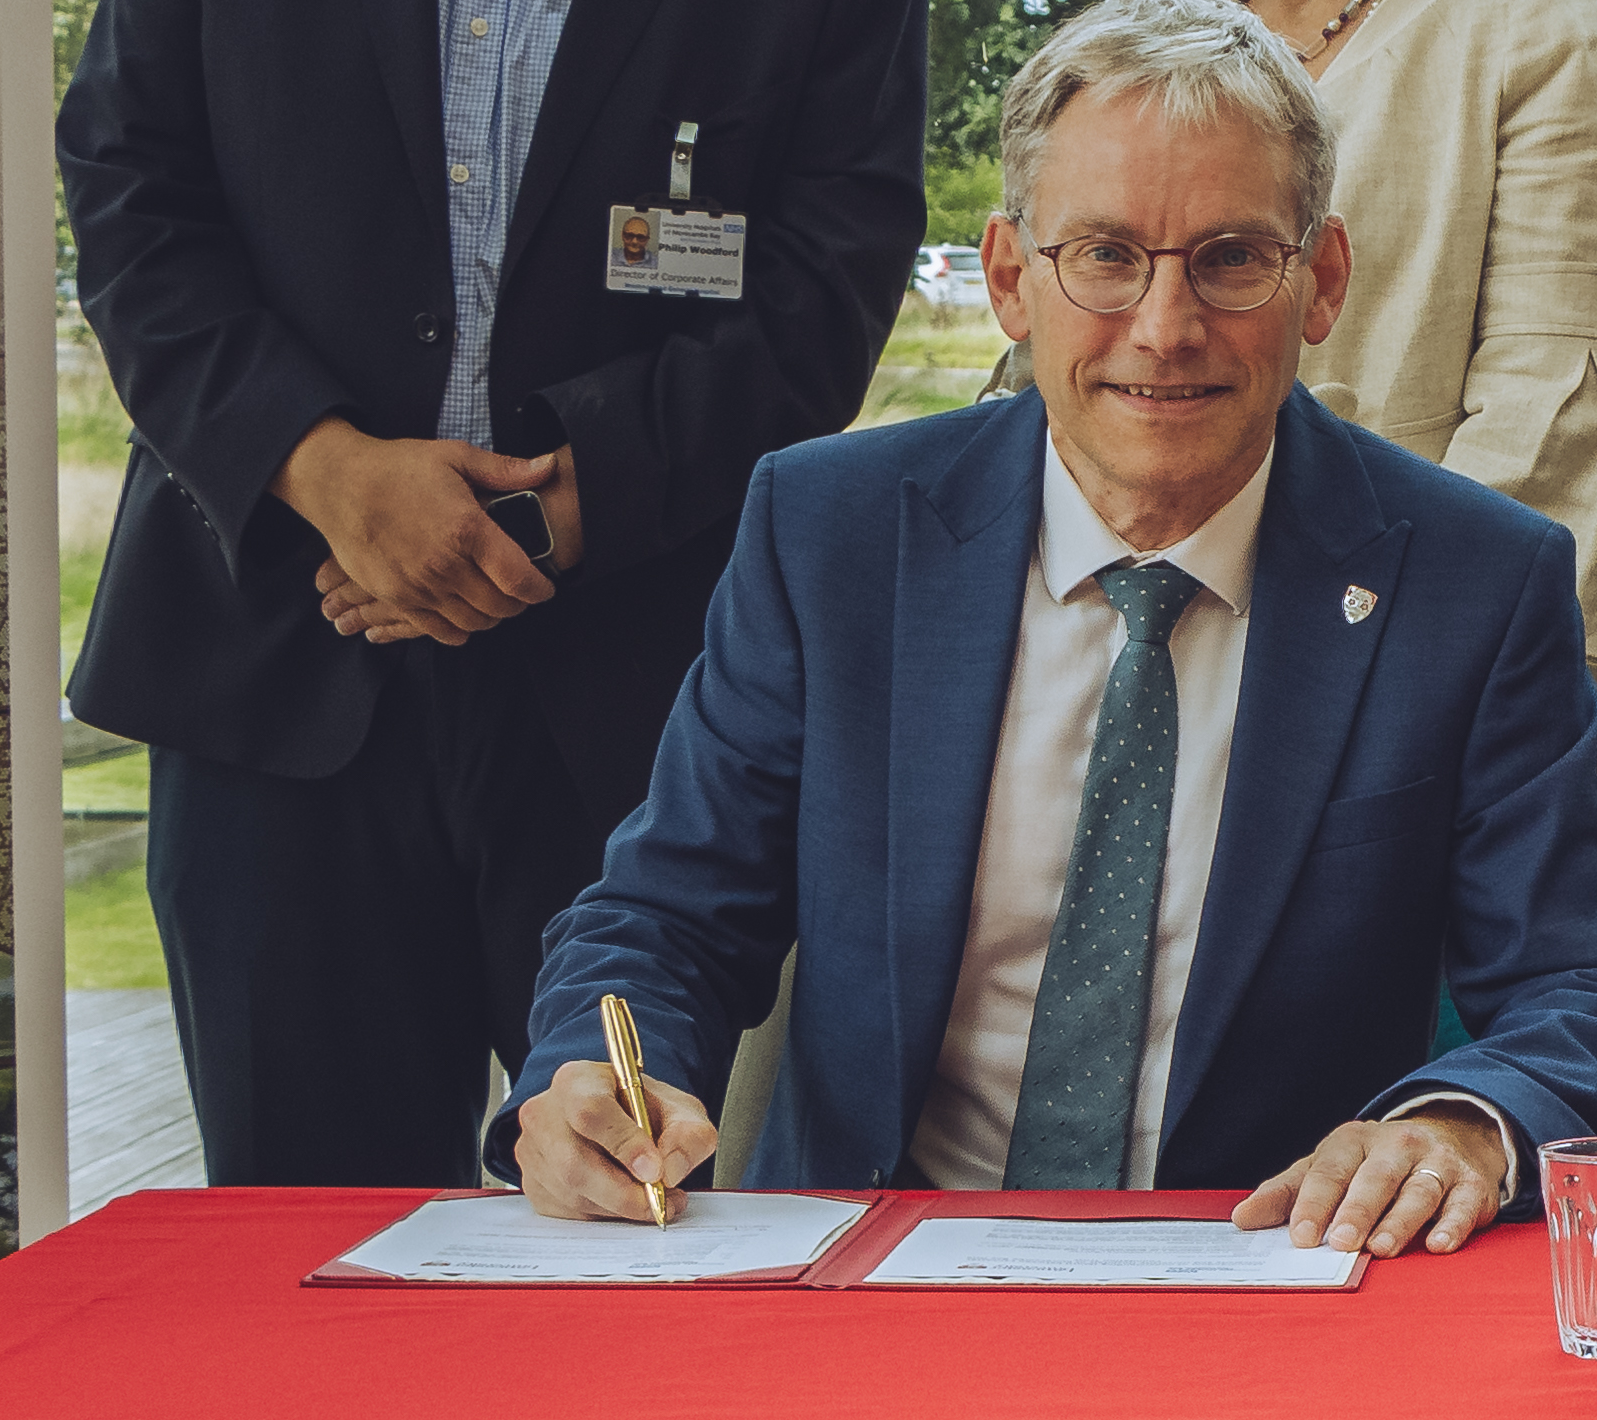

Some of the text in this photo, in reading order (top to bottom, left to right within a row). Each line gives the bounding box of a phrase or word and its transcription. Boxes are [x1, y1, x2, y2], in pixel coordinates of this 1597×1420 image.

[658, 243, 739, 257] Philip Woodford
[610, 269, 646, 279] Director
[649, 272, 659, 280] of
[661, 272, 706, 284] Corporate
